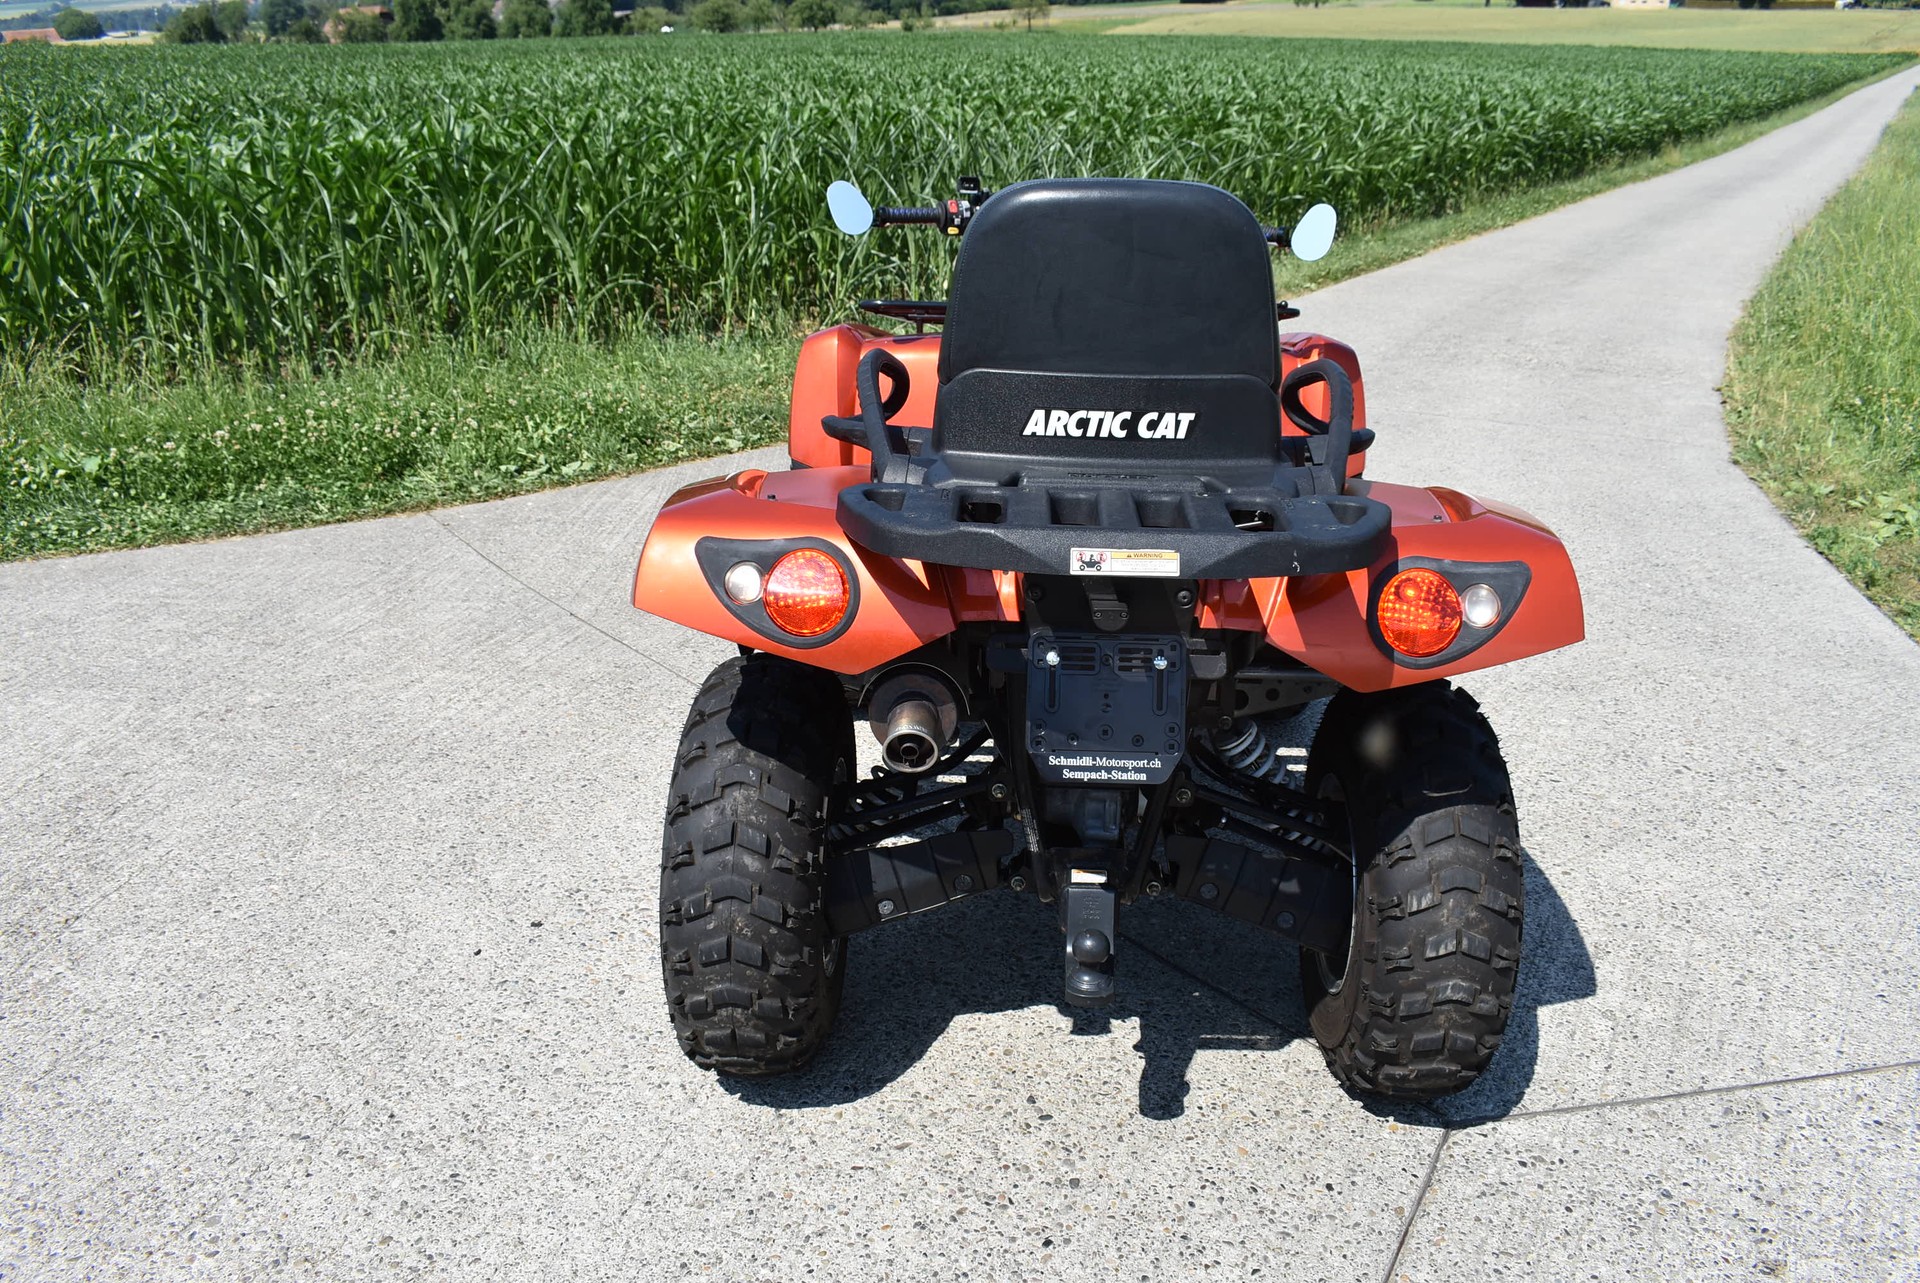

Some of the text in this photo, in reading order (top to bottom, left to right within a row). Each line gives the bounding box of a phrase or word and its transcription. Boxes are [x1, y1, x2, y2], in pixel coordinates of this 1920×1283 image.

[1022, 409, 1196, 439] ARCTIC CAT
[1048, 755, 1161, 769] Schmidli-Motorsport.ch
[1062, 769, 1147, 782] Sempach-Station
